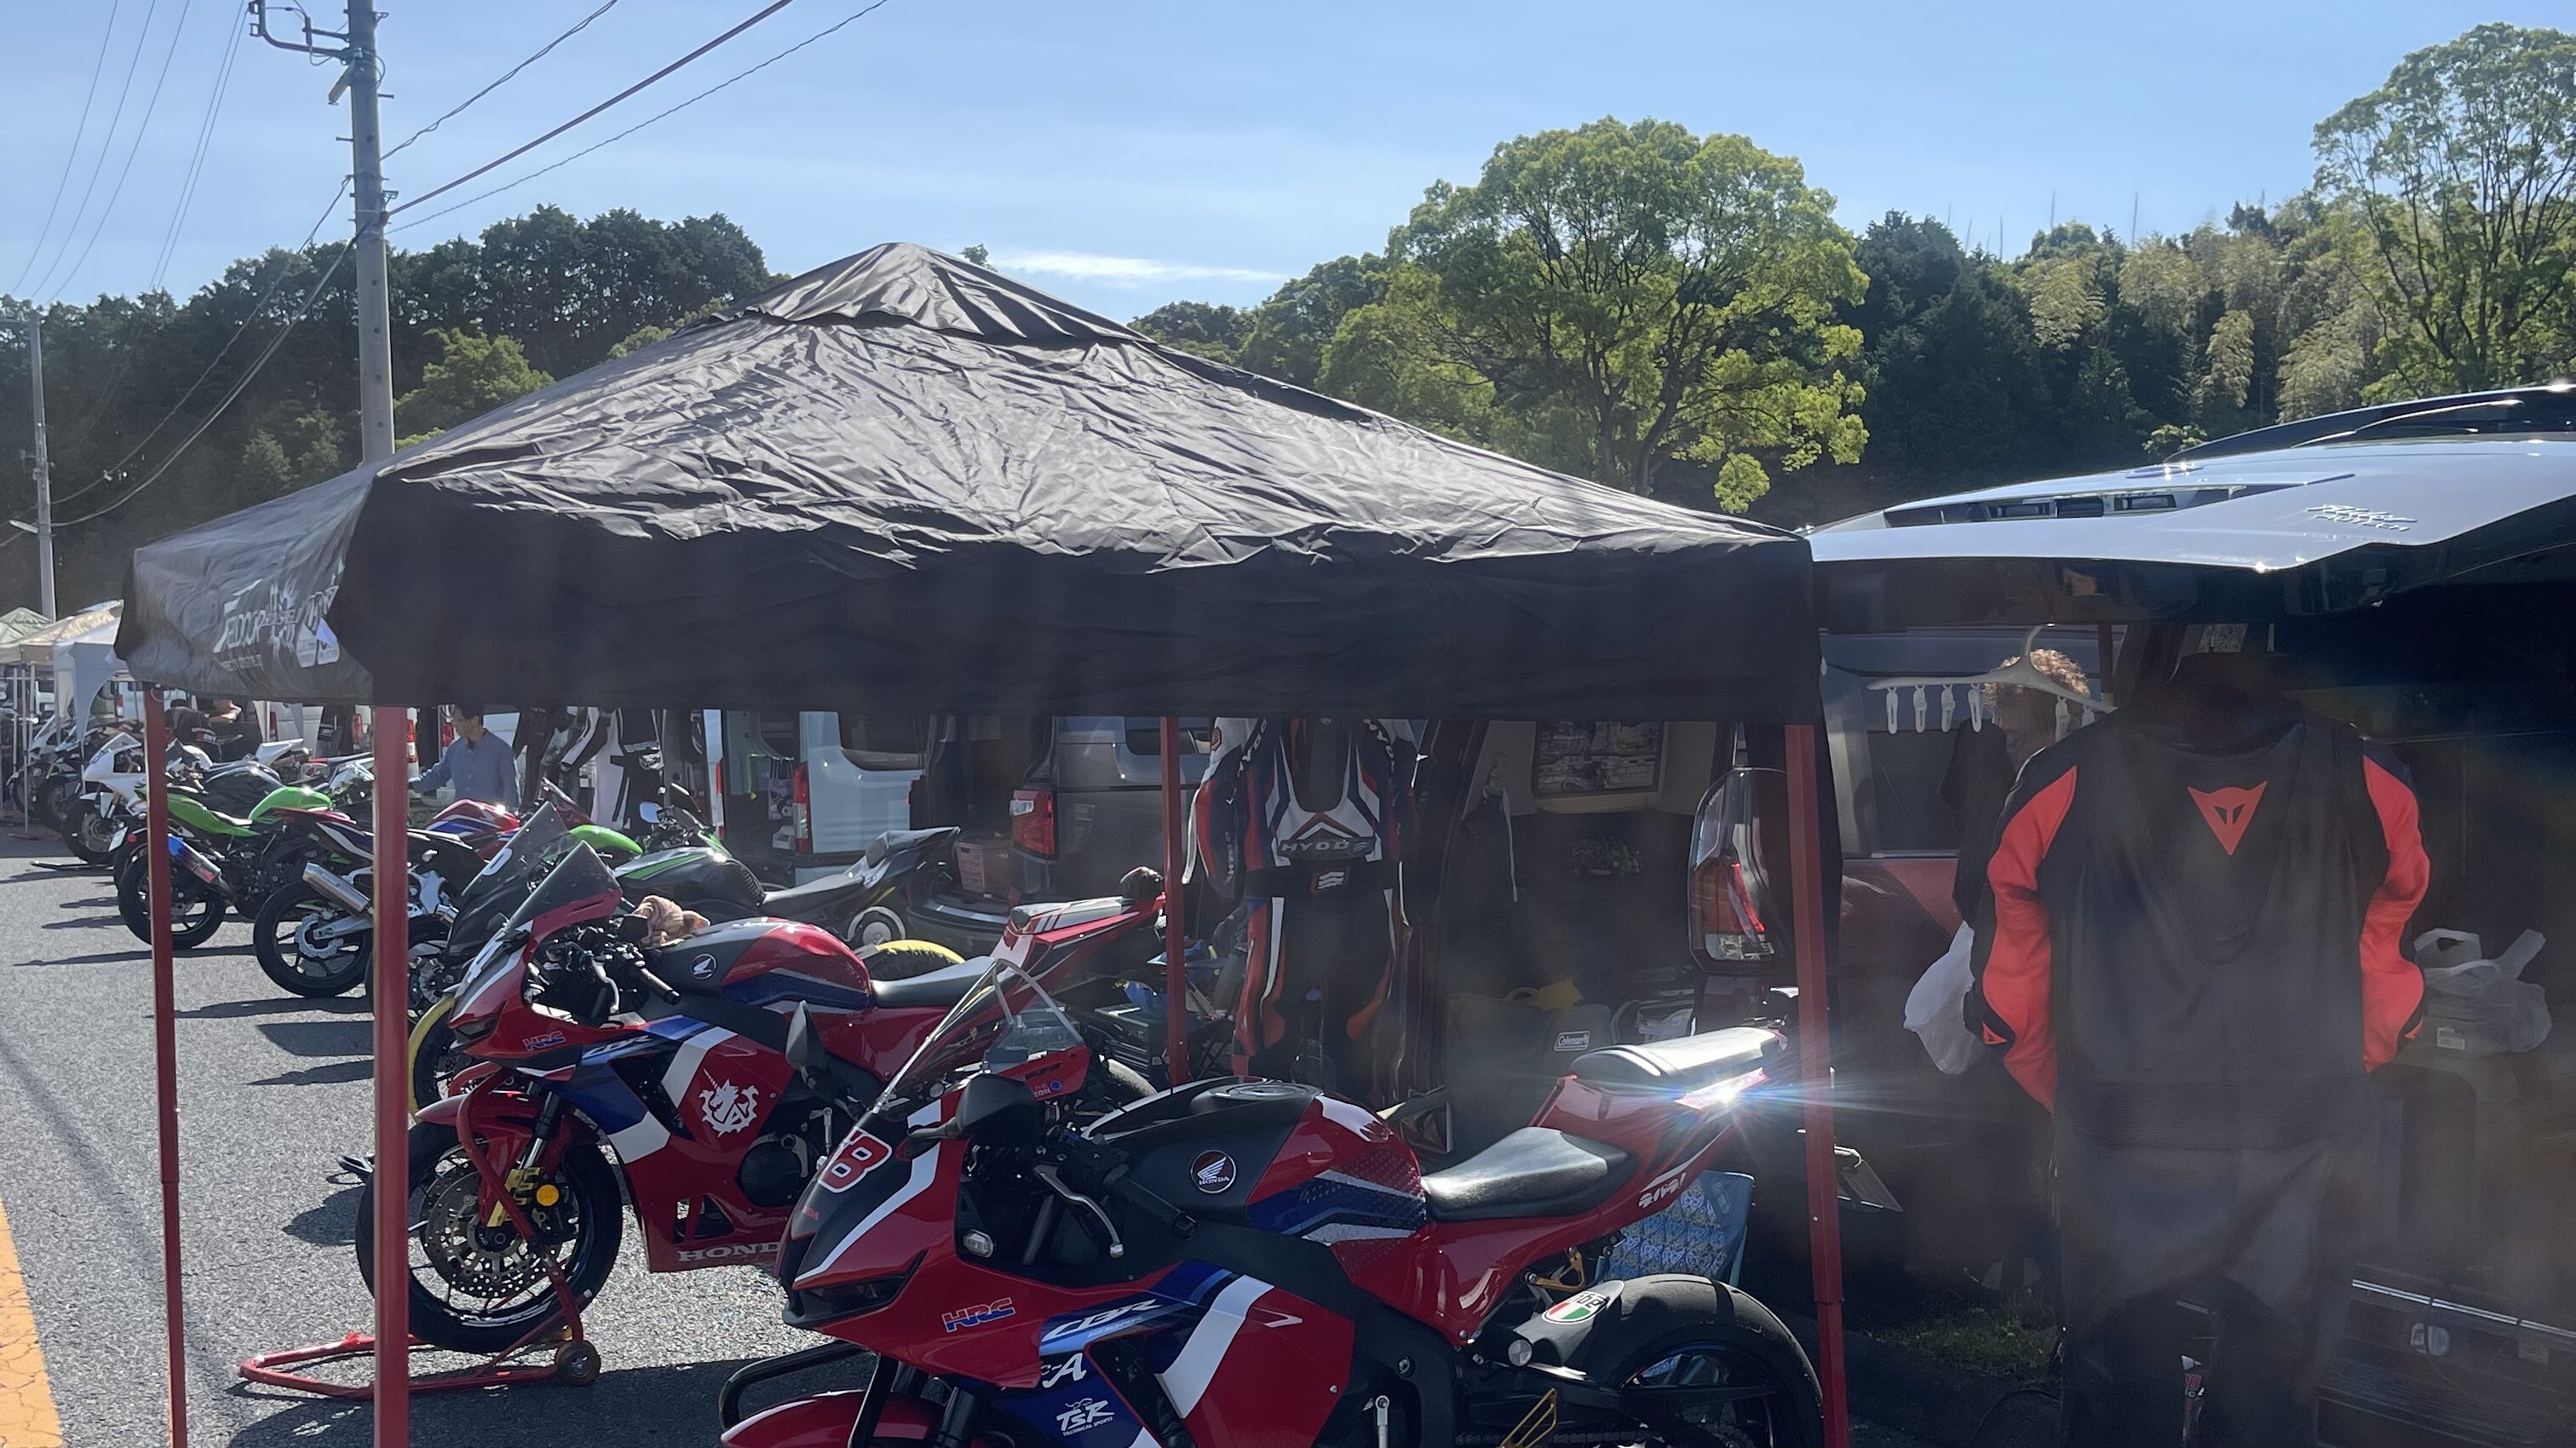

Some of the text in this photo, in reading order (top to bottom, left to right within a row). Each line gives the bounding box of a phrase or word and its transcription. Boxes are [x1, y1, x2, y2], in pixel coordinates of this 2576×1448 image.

[521, 1030, 566, 1052] HRC
[1199, 1176, 1230, 1186] HONDA
[677, 1241, 780, 1262] HOND
[941, 1296, 1016, 1333] HRC
[1041, 1298, 1164, 1342] CBR
[1093, 1416, 1113, 1429] SPORTS
